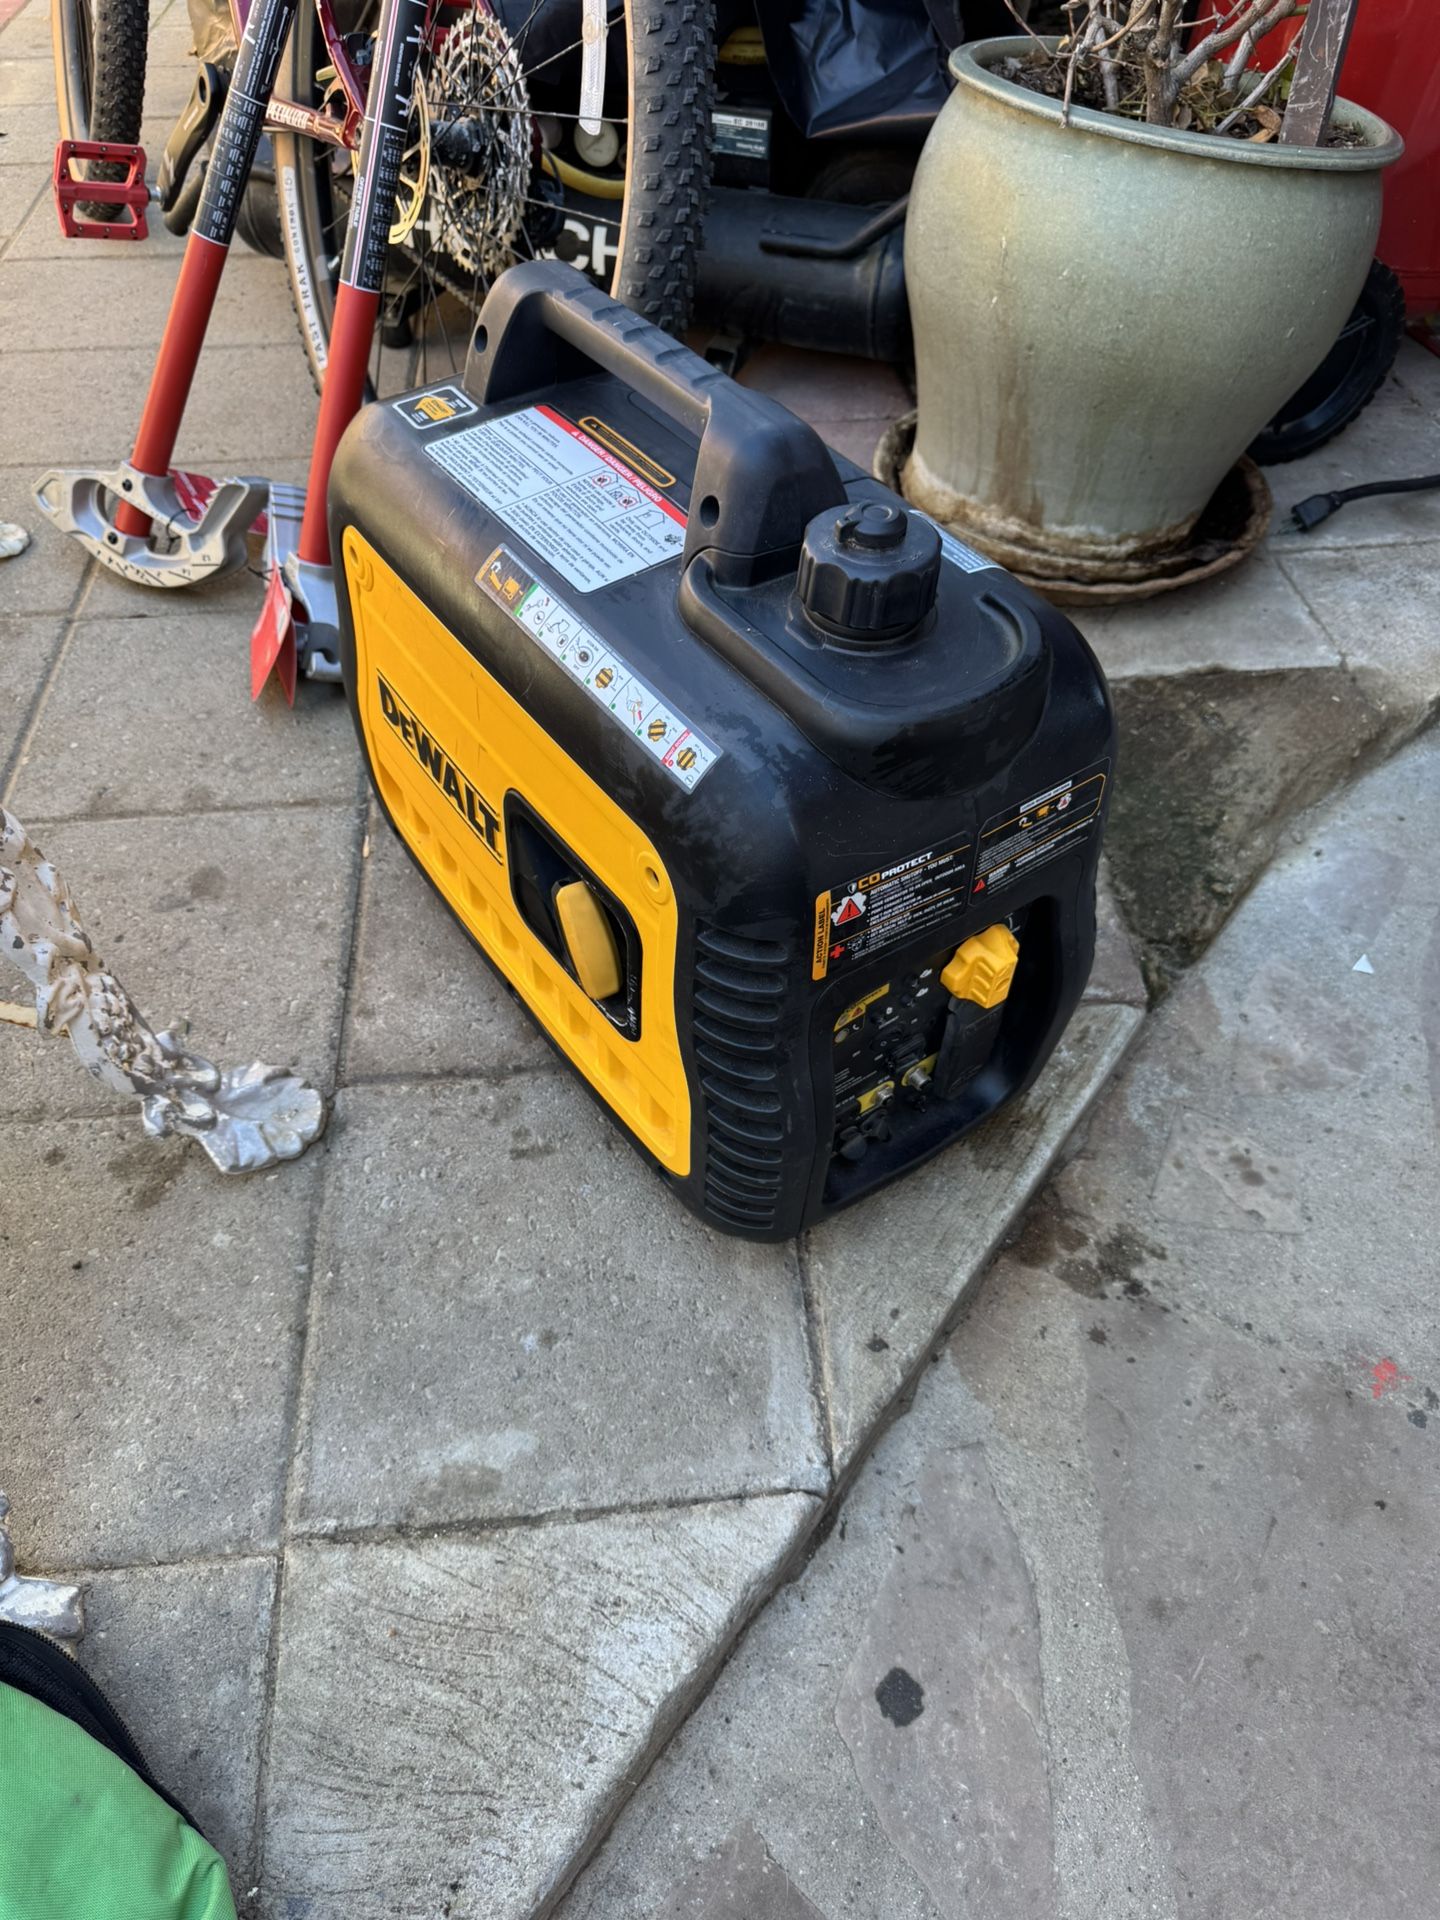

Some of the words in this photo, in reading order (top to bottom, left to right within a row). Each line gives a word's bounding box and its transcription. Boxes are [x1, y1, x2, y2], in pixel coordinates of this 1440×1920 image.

[265, 102, 311, 129] PECIALIZED
[297, 264, 311, 309] TRAK
[308, 322, 326, 362] FAST
[576, 435, 605, 455] DANGER
[601, 455, 633, 478] DANGER
[630, 478, 663, 502] PELIGRO
[377, 676, 500, 851] DEWALT
[856, 871, 881, 890] CO
[880, 850, 933, 880] PROTECT
[817, 907, 825, 937] LABEL
